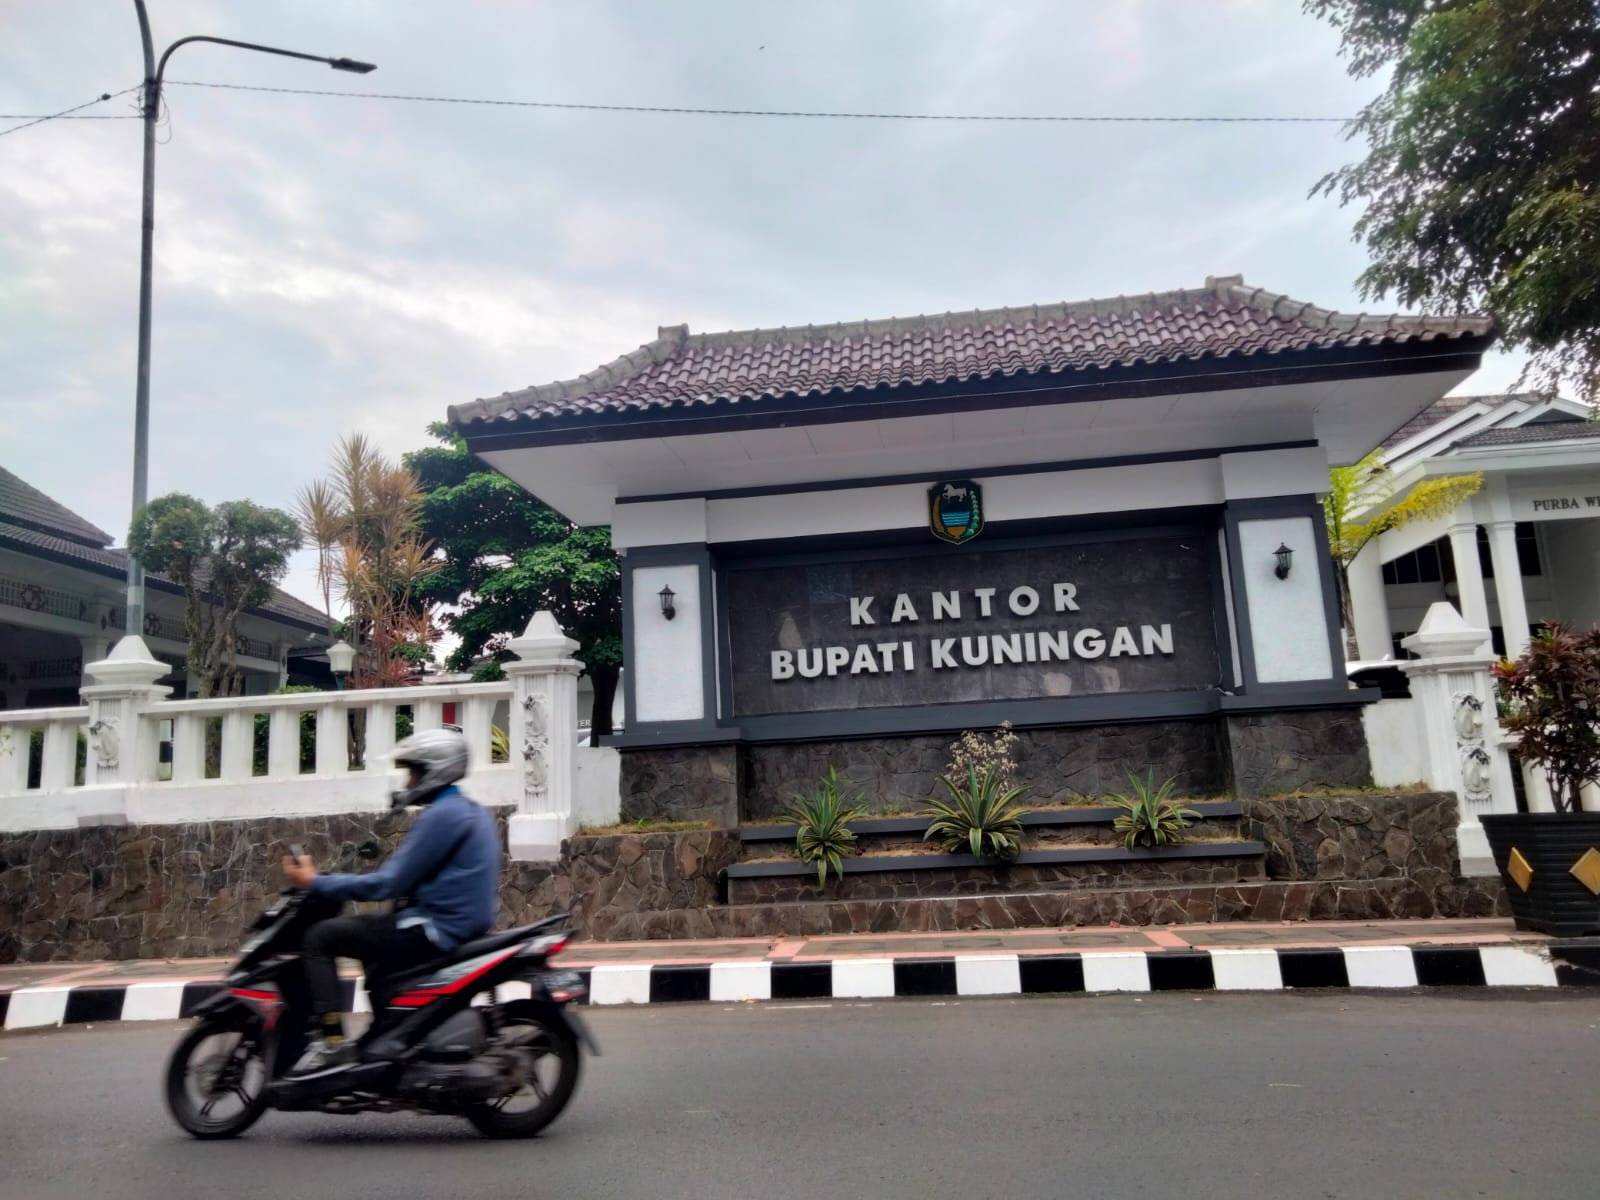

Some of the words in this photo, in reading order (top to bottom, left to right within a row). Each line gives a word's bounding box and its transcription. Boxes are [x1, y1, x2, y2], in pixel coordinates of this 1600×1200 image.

[1533, 498, 1580, 512] PURBA
[850, 582, 1081, 626] KANTOR
[771, 641, 915, 680] BUPATI
[931, 623, 1175, 669] KUNINGAN
